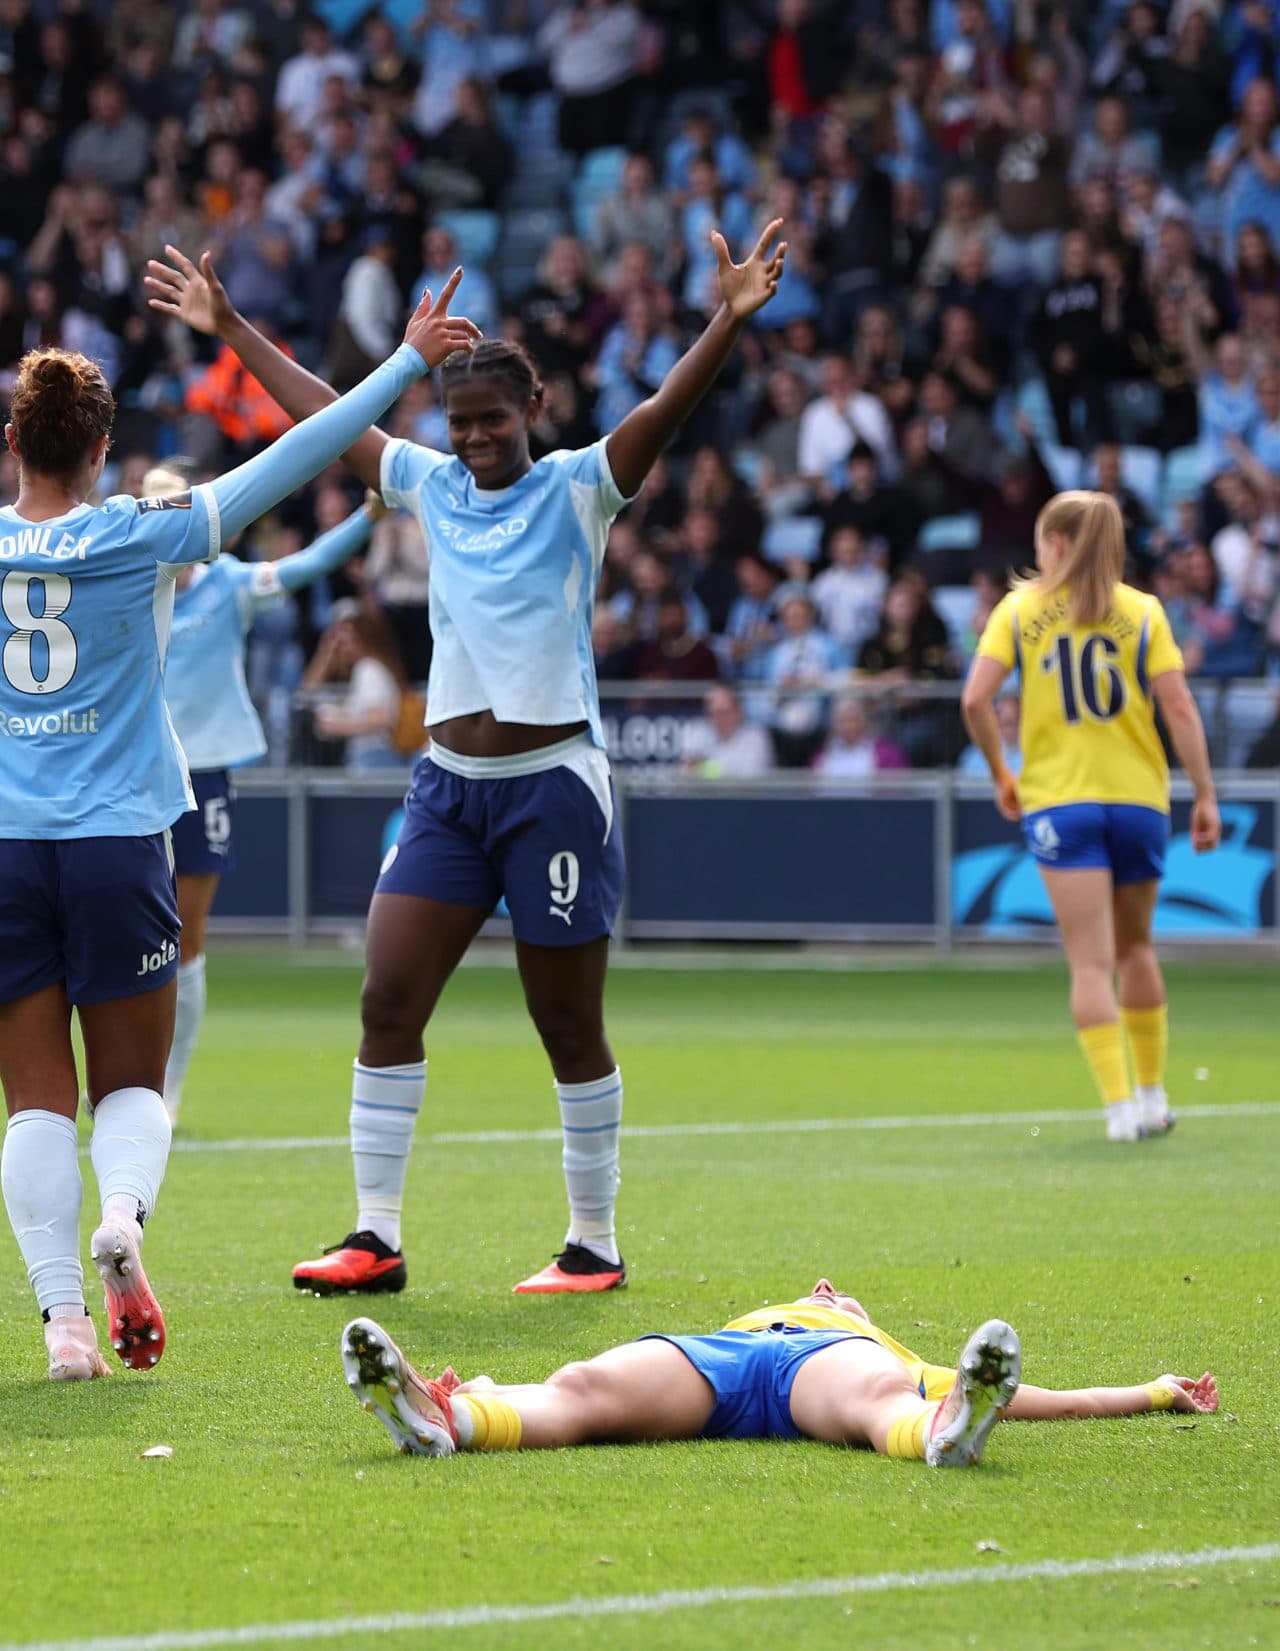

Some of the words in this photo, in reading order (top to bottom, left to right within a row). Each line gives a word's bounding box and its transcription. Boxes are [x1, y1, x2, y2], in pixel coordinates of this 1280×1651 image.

[1, 569, 78, 695] 8
[1041, 633, 1127, 724] 16
[204, 797, 231, 844] 5
[548, 850, 580, 905] 9
[136, 938, 177, 976] Joie
